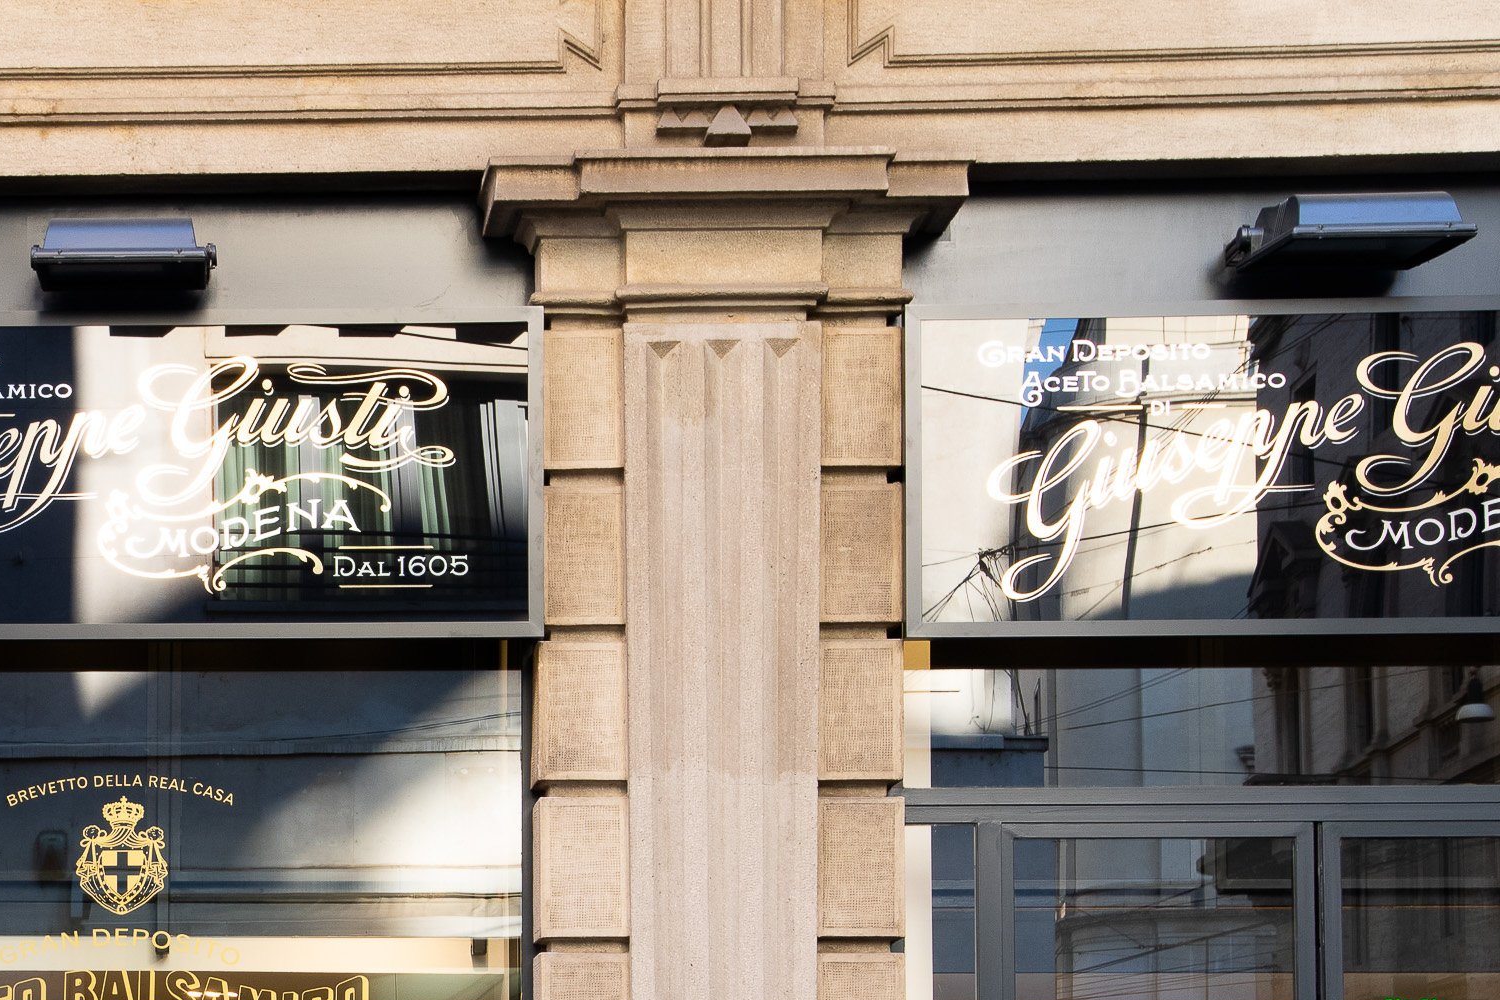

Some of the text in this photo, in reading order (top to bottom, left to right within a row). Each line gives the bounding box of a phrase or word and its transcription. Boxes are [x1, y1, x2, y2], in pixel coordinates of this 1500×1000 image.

[977, 339, 1211, 368] GRAN DEPOSITO
[1019, 369, 1287, 407] ACETO BALSAMICO
[1150, 400, 1171, 417] DI
[135, 355, 456, 506] Giusti
[986, 392, 1365, 603] Giuseppe
[127, 499, 362, 560] MODENA
[397, 553, 469, 577] 1605
[6, 774, 234, 807] BREVETTO DELLA REAL CASA
[92, 927, 241, 966] DEPOSITO
